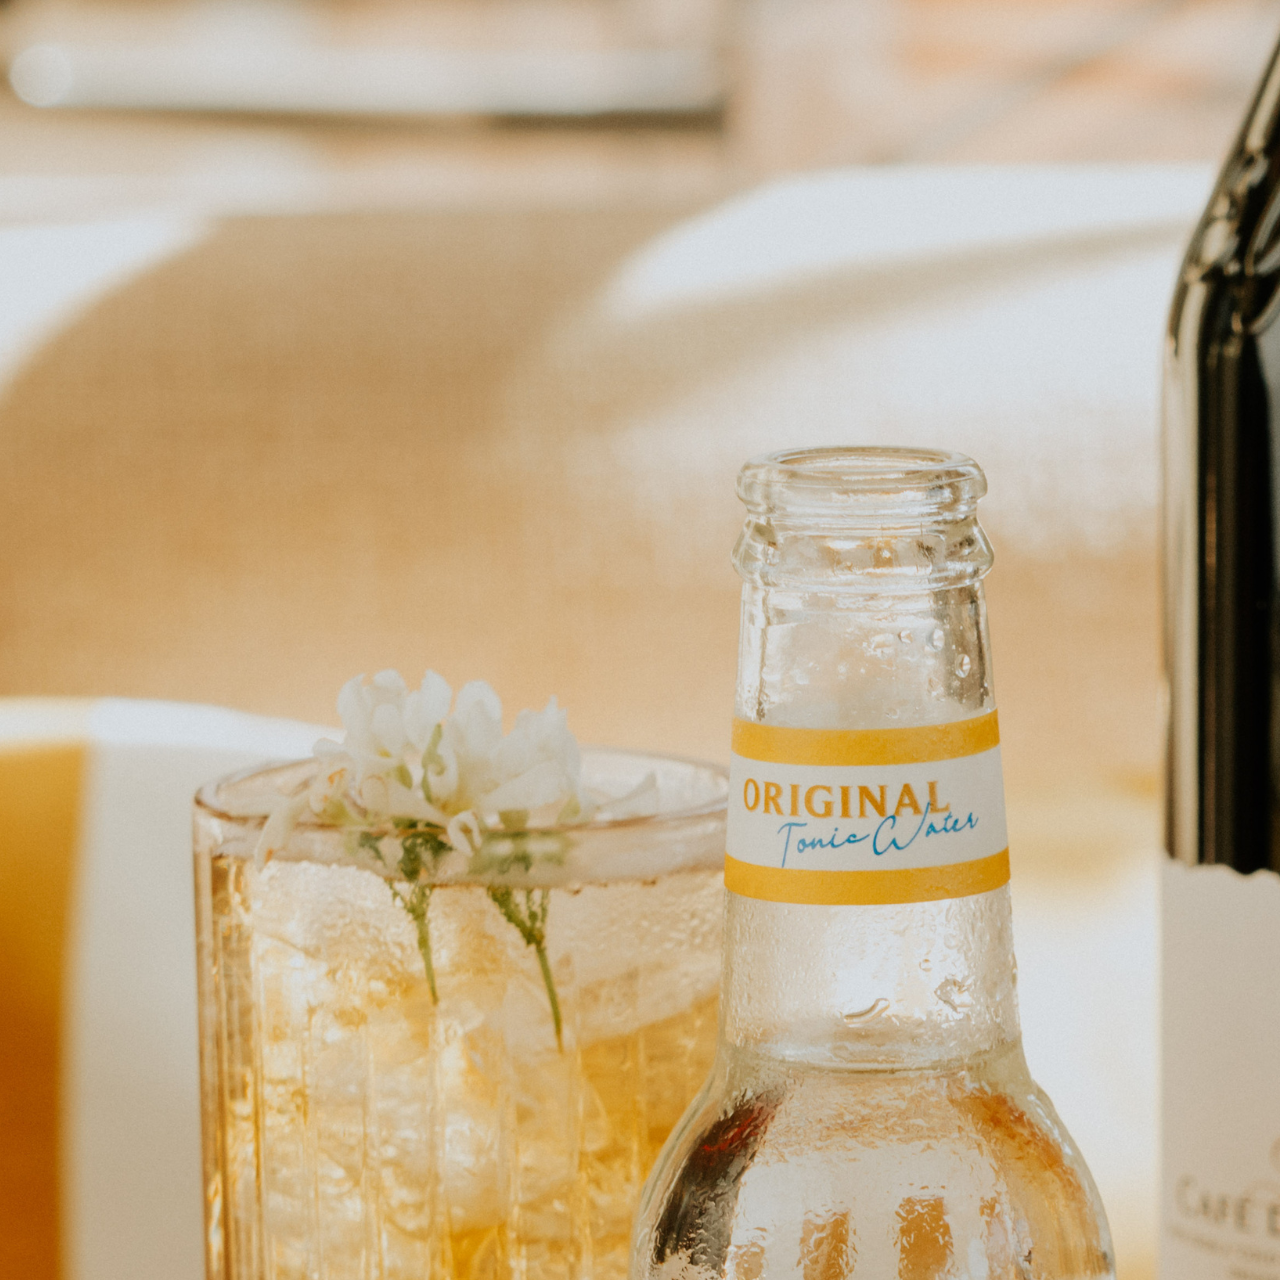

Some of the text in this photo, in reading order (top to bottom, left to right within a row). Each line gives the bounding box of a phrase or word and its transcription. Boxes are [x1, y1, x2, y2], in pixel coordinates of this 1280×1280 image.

[743, 778, 951, 818] ORIGINAL
[777, 801, 979, 868] Tonic Water
